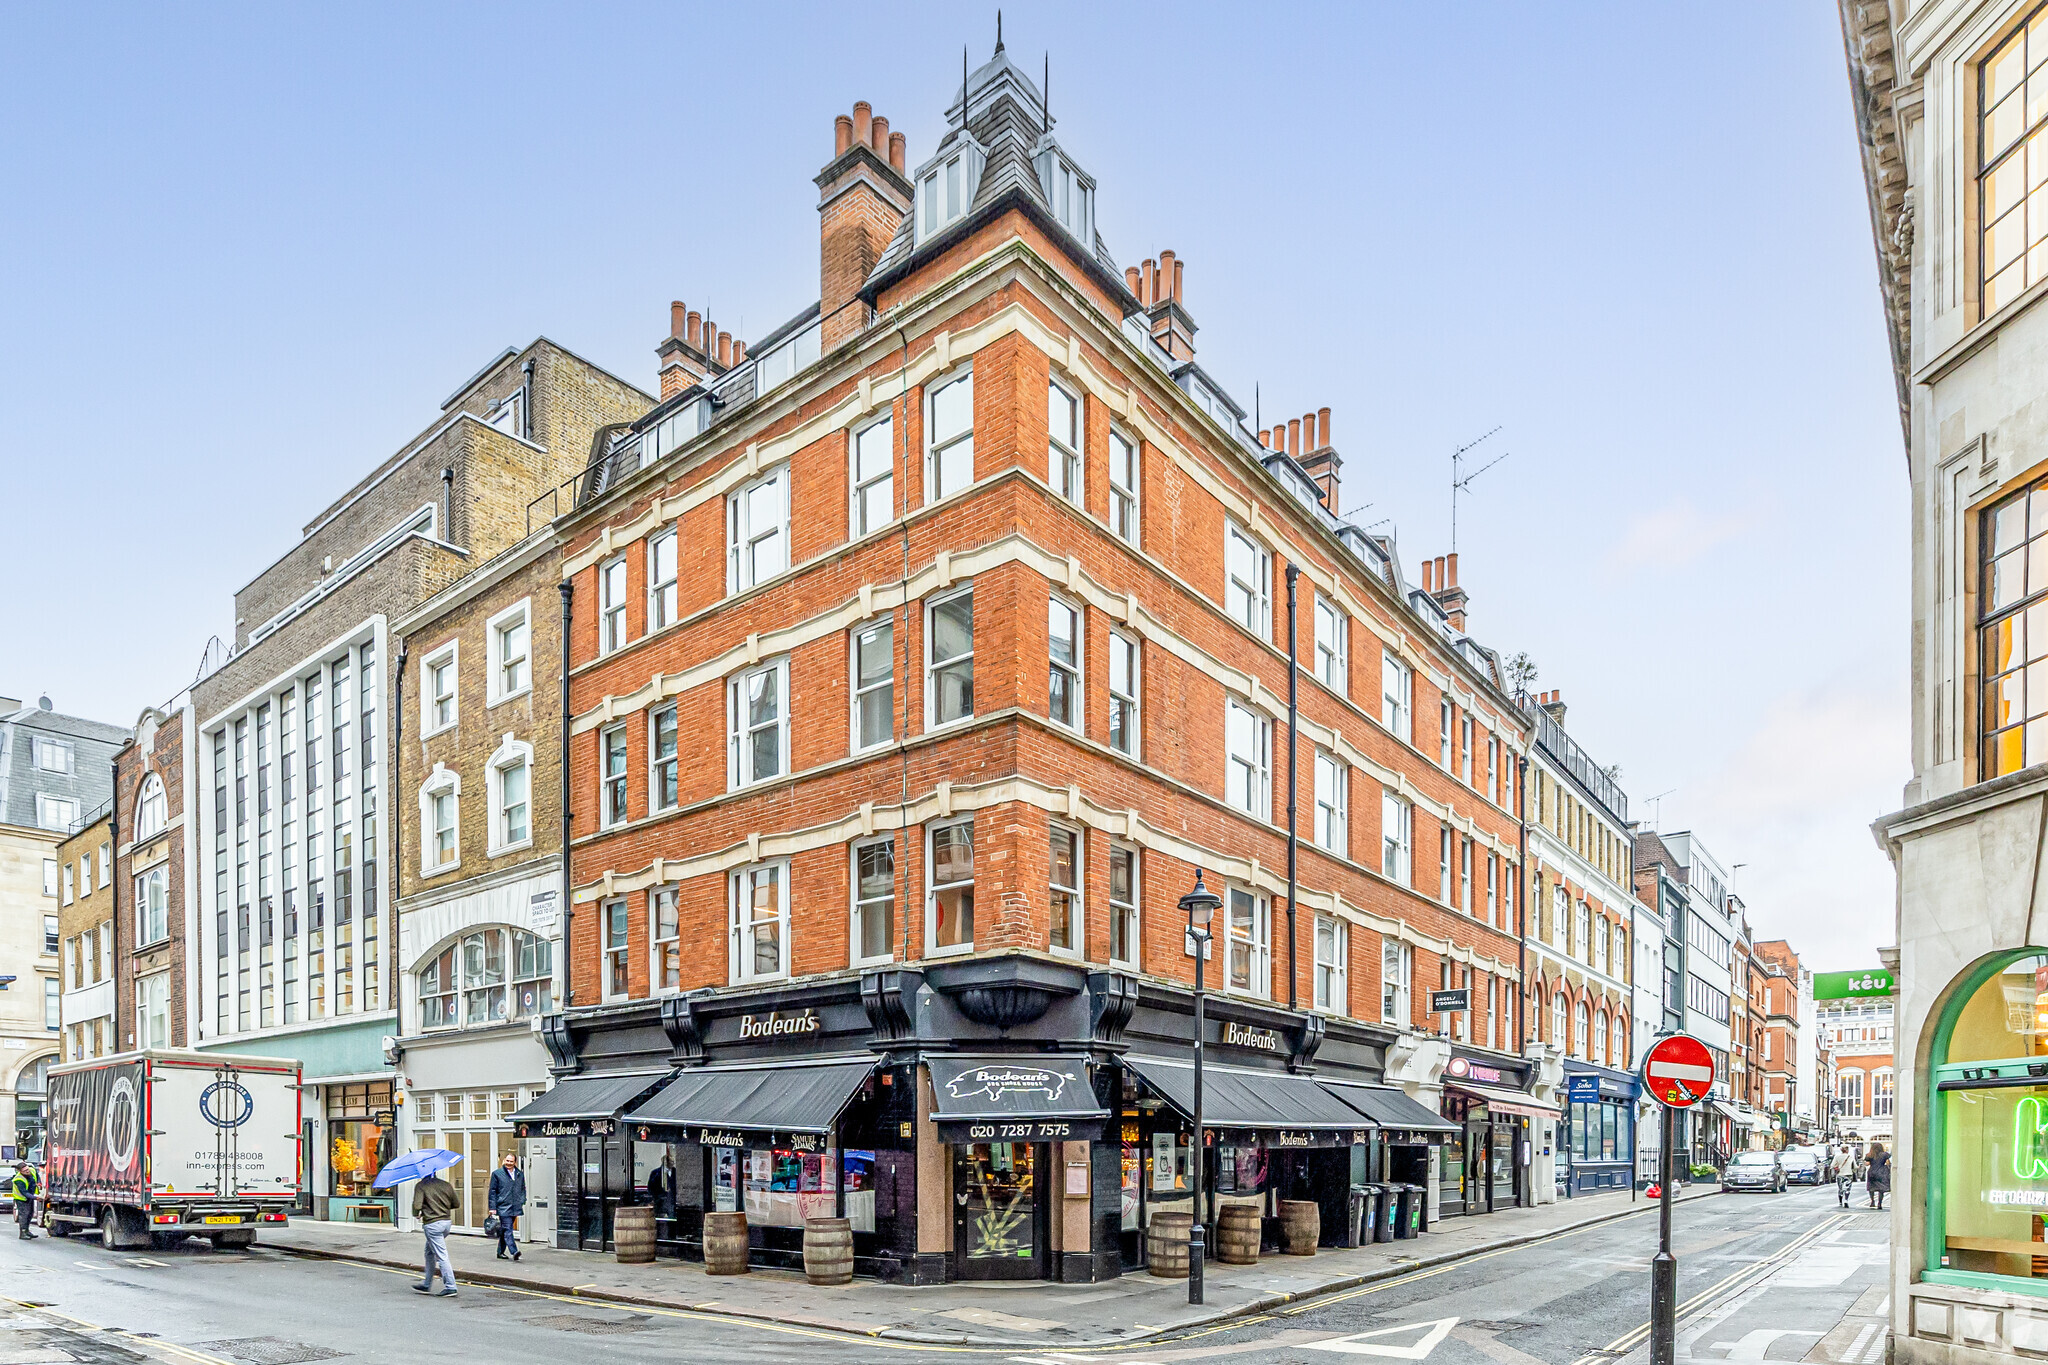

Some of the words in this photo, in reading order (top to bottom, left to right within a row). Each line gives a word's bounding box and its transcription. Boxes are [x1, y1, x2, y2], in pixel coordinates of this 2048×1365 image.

[739, 1008, 817, 1038] Bodean's
[1227, 1022, 1276, 1050] Bodean's
[976, 1071, 1050, 1081] Bodean's
[970, 1125, 995, 1138] 020
[1000, 1124, 1033, 1137] 7287
[1038, 1123, 1070, 1136] 7575
[700, 1129, 744, 1147] Bodean's
[790, 1133, 817, 1144] SAMUEL
[792, 1142, 816, 1152] ADAMS
[194, 1151, 226, 1160] 01789
[186, 1161, 265, 1171] inn-express.com
